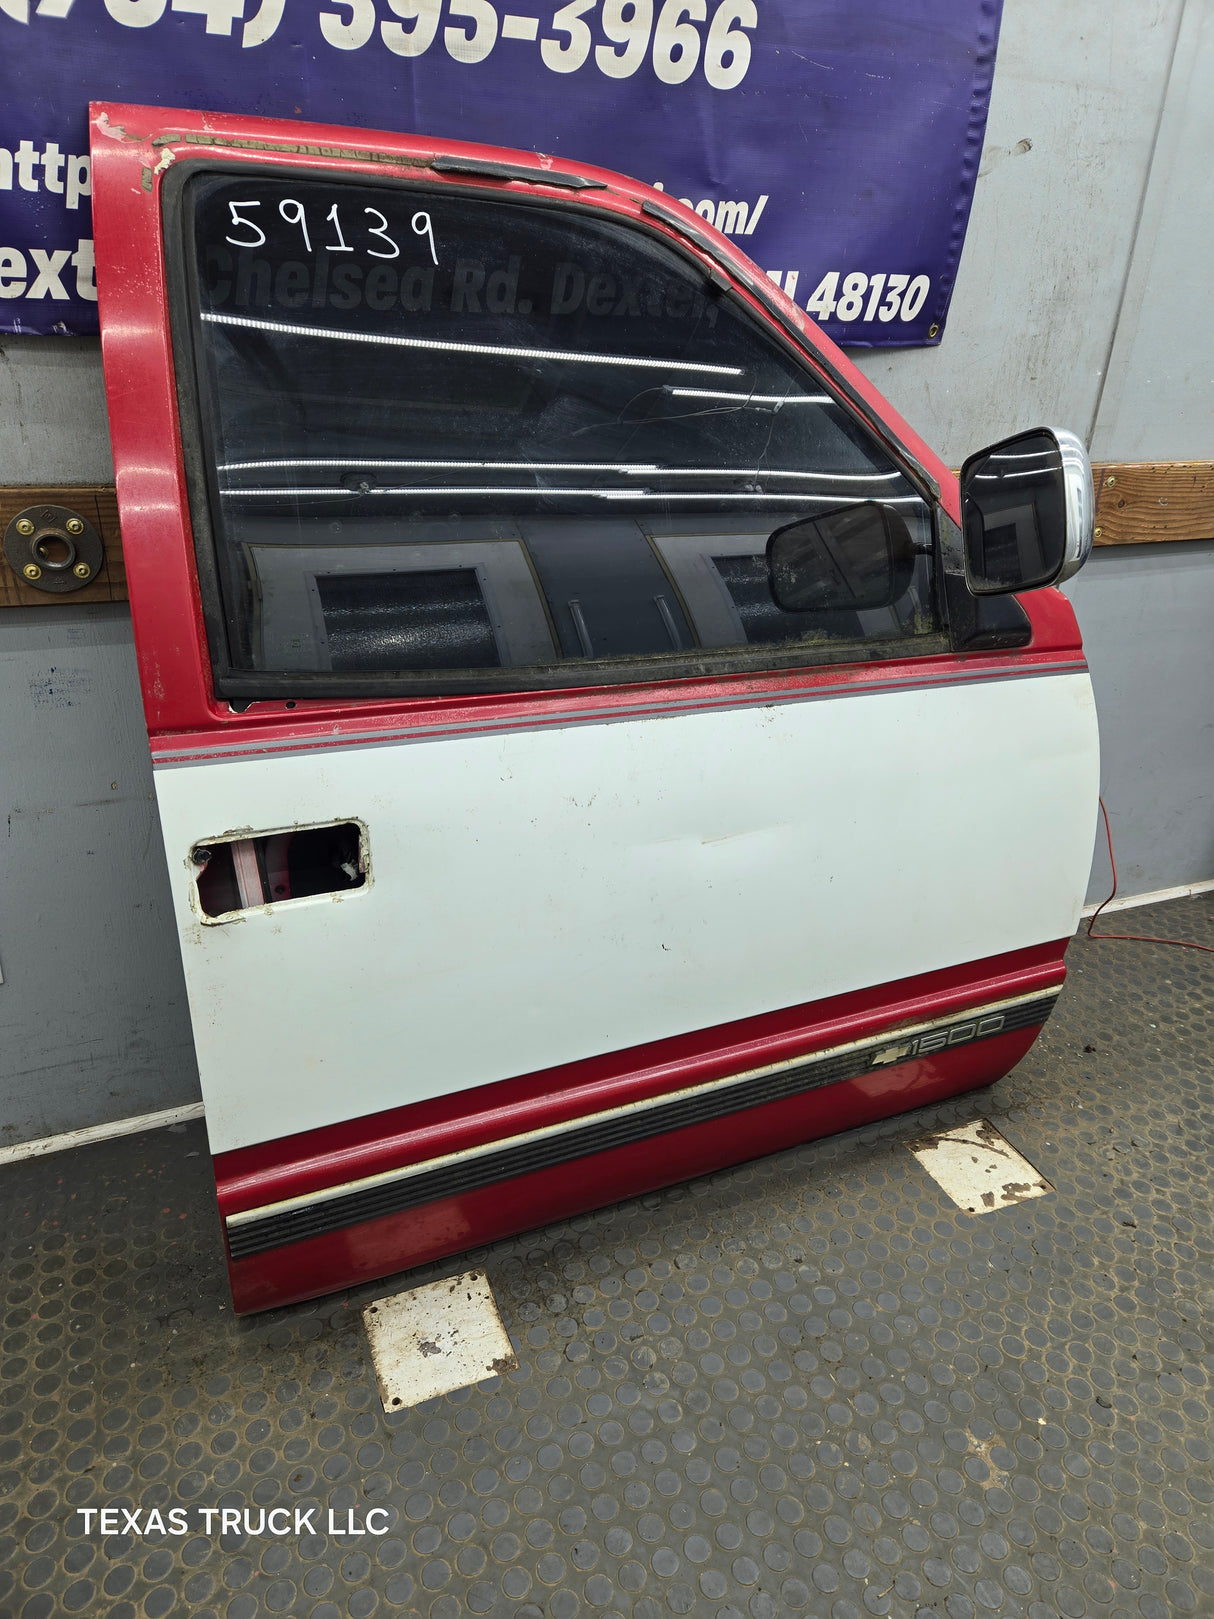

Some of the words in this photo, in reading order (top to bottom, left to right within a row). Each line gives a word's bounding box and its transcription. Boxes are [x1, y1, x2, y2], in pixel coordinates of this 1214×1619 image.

[320, 0, 758, 90] 395-3966
[226, 199, 439, 265] 59139
[203, 244, 435, 312] Chelsea
[451, 255, 533, 314] Rd.
[806, 271, 930, 322] 48130
[911, 1015, 1006, 1055] 1500
